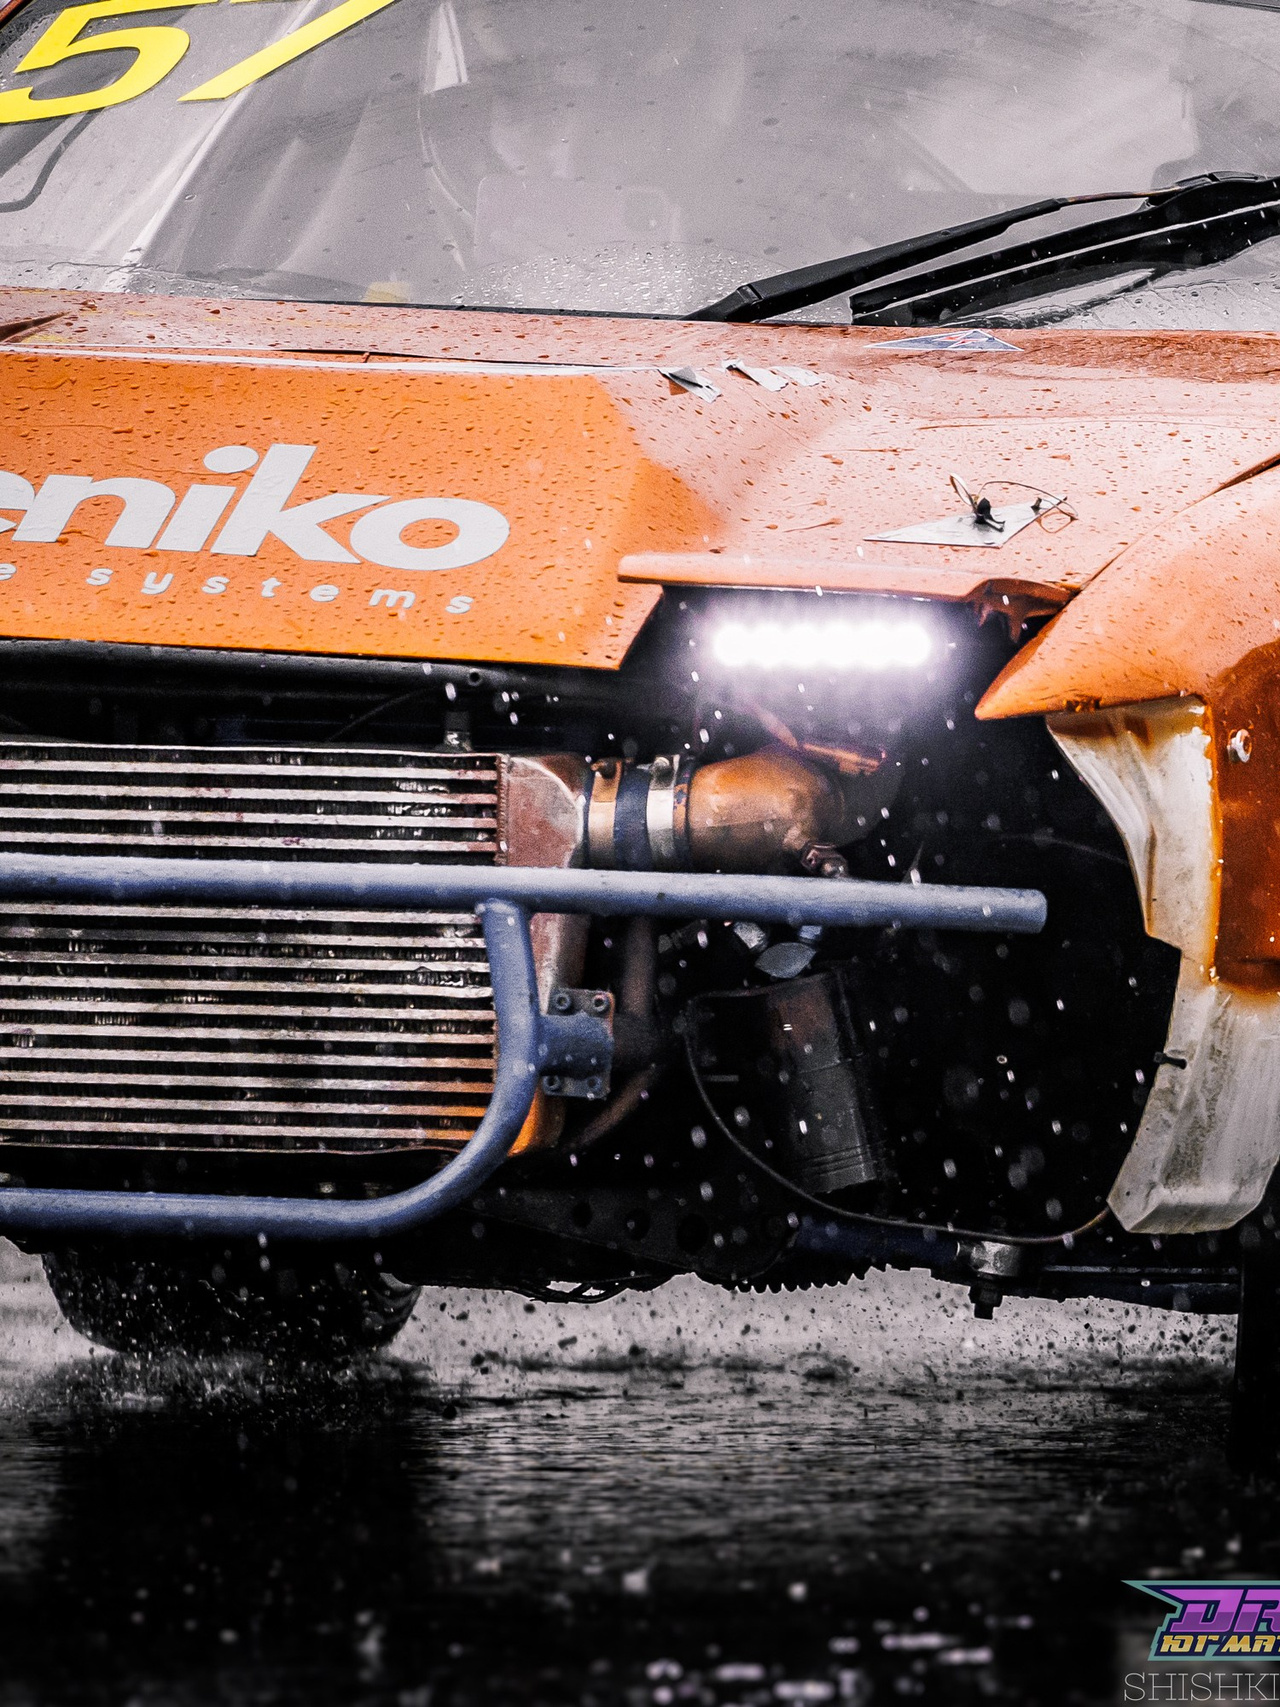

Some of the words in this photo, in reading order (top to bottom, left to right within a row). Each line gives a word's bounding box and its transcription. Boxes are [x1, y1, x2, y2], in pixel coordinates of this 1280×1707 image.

[0, 0, 396, 124] 57
[0, 441, 511, 572] niko
[85, 567, 475, 615] systems
